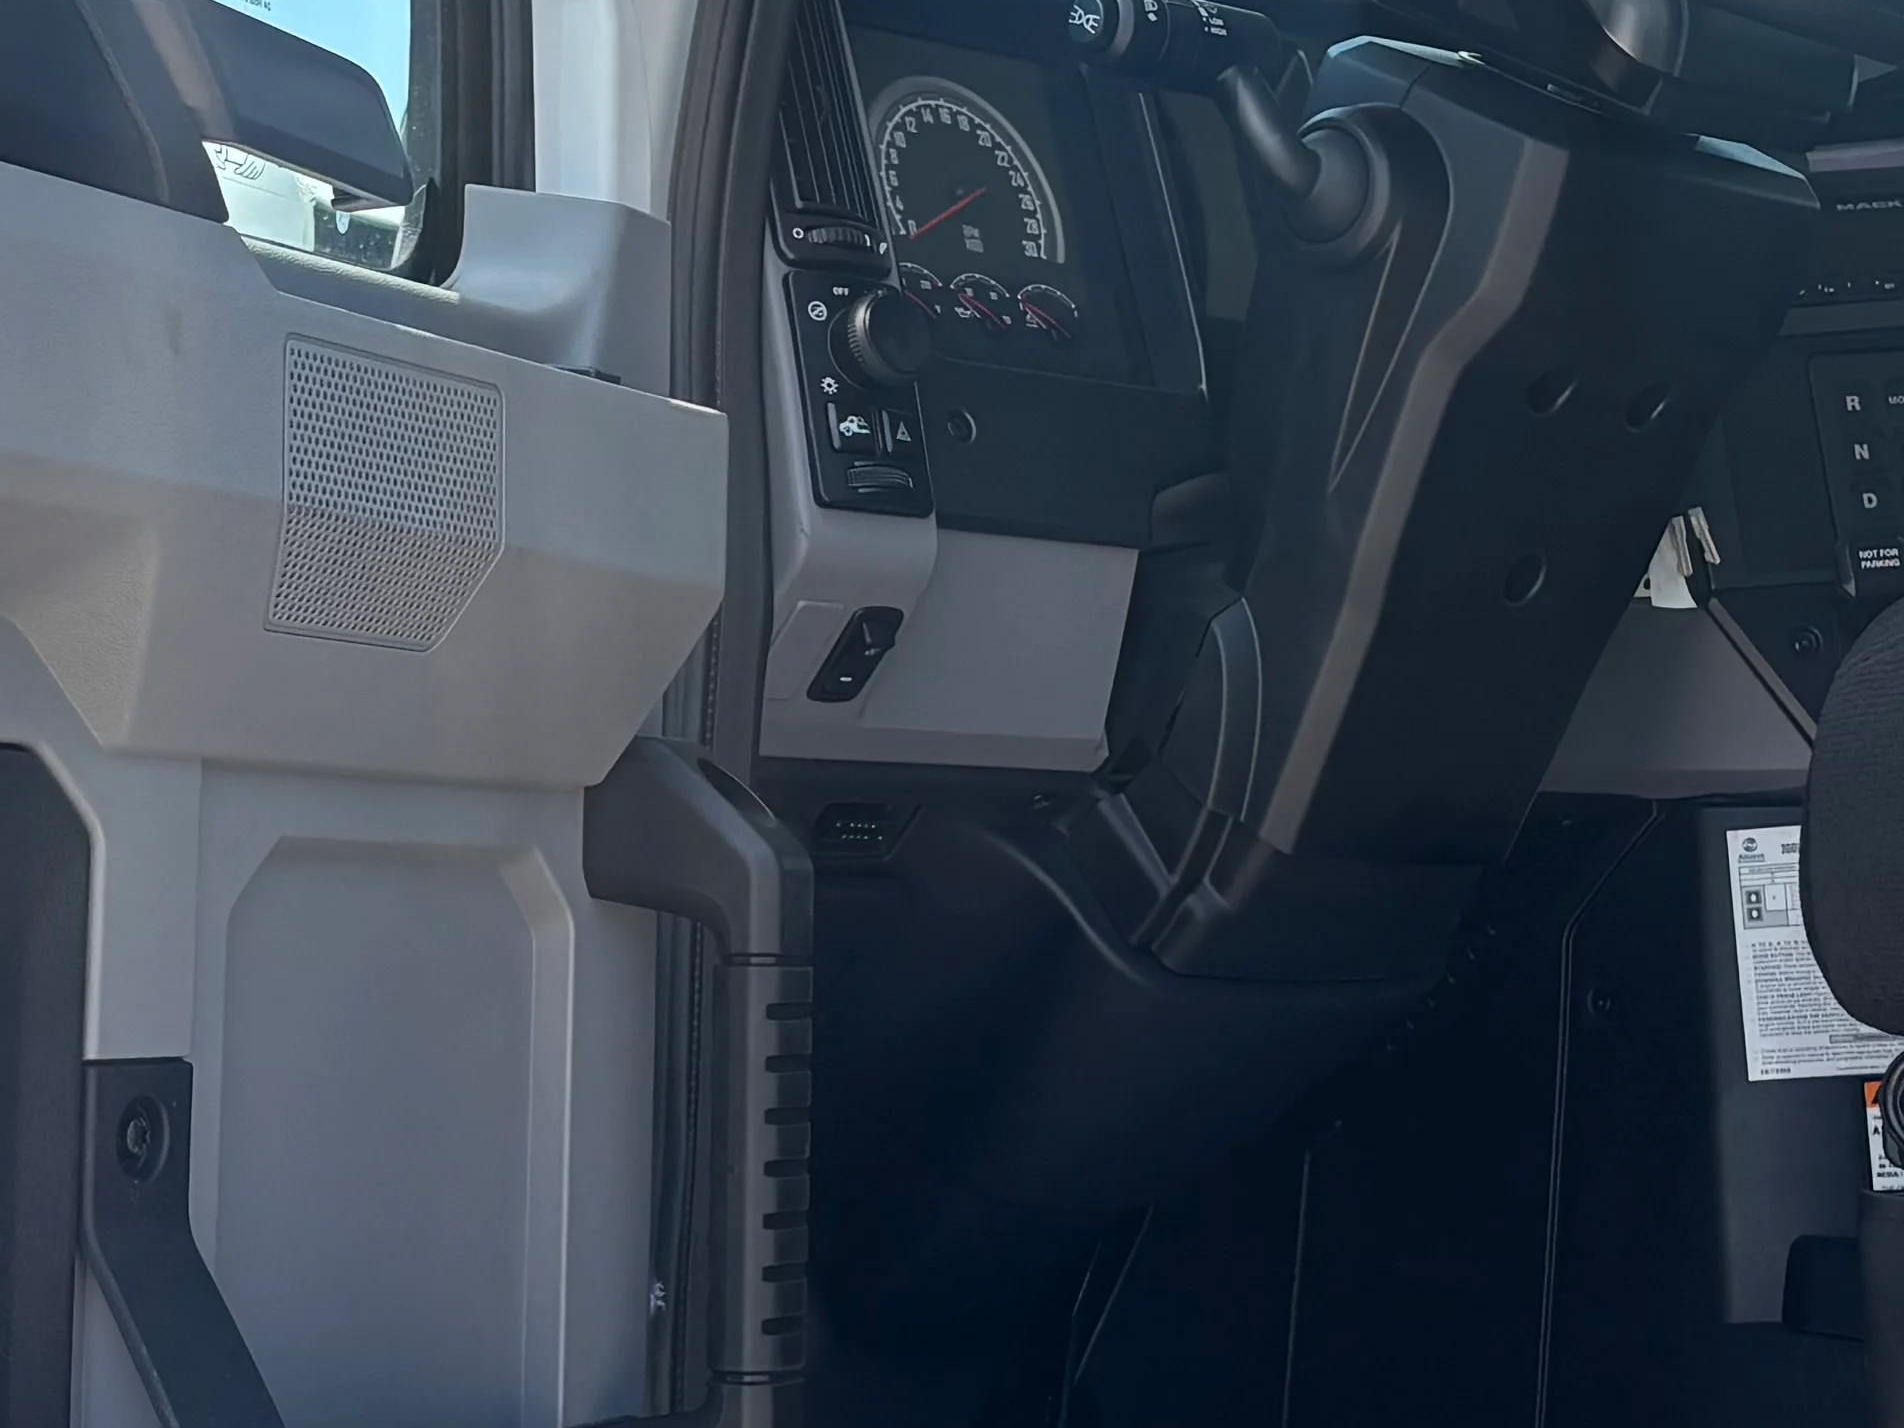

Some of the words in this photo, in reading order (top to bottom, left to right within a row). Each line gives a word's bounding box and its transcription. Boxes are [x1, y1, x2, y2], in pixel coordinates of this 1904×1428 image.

[921, 107, 934, 124] 14
[905, 116, 918, 133] 12
[893, 131, 907, 148] 10
[976, 130, 992, 147] 20
[995, 150, 1010, 167] 22
[1009, 171, 1025, 186] 24
[896, 195, 904, 211] 4
[1836, 200, 1903, 211] MACK
[1022, 240, 1038, 257] 30
[1845, 395, 1861, 411] R
[1854, 443, 1870, 460] N
[1862, 492, 1878, 509] D
[1859, 548, 1878, 559] NOT
[1879, 548, 1899, 558] FOR
[1861, 558, 1901, 570] PARKING
